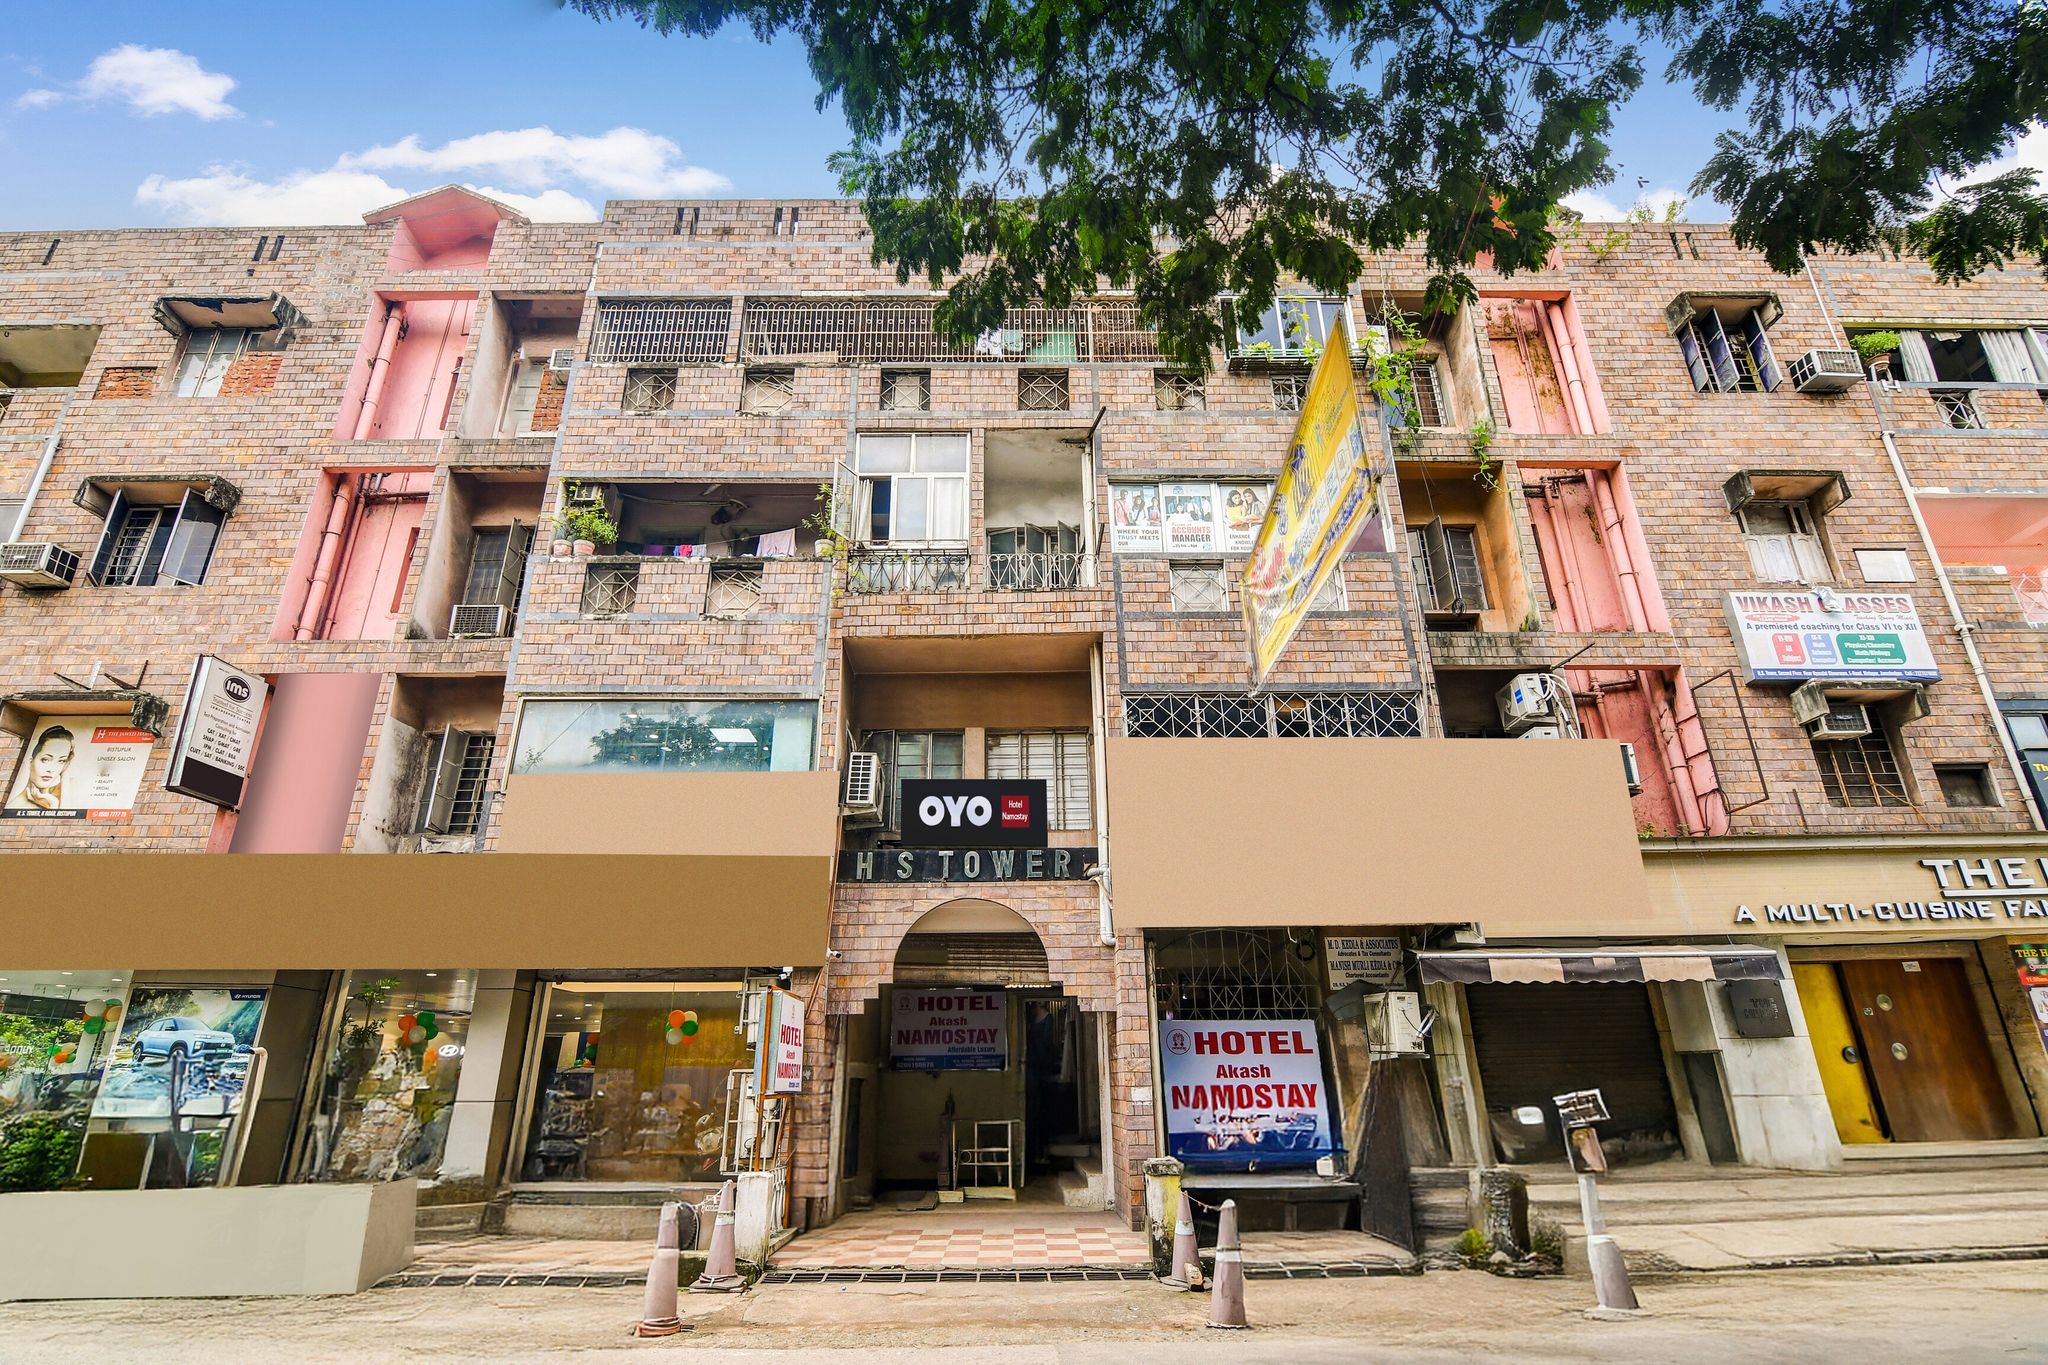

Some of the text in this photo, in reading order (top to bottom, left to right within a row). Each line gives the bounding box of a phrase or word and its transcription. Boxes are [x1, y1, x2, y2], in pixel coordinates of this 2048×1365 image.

[1172, 526, 1211, 534] ACCOUNTS
[1172, 534, 1211, 543] MANAGER
[1736, 596, 1911, 613] VIKASH CASSES
[1746, 622, 1753, 630] A
[1755, 622, 1799, 631] premiered
[1801, 622, 1841, 632] coaching
[1856, 623, 1880, 631] Class
[1904, 623, 1918, 631] XII
[190, 746, 201, 755] CUET
[919, 795, 992, 827] OYO
[1008, 800, 1023, 809] Hotel
[1002, 811, 1028, 822] Namostay
[856, 850, 1071, 880] H S TOWER
[1919, 858, 2035, 888] THE
[1735, 904, 1757, 922] A
[1764, 901, 1997, 922] MULTI-CUISINE
[2015, 948, 2038, 957] THE
[918, 995, 999, 1011] HOTEL
[929, 1016, 967, 1026] Akash
[780, 1023, 802, 1047] HOTEL
[897, 1028, 998, 1045] NAMOSTAY
[1194, 1031, 1314, 1055] HOTEL
[777, 1062, 801, 1079] NAMOSTAY
[1216, 1064, 1271, 1079] Akash
[1171, 1083, 1318, 1111] NAMOSTAY
